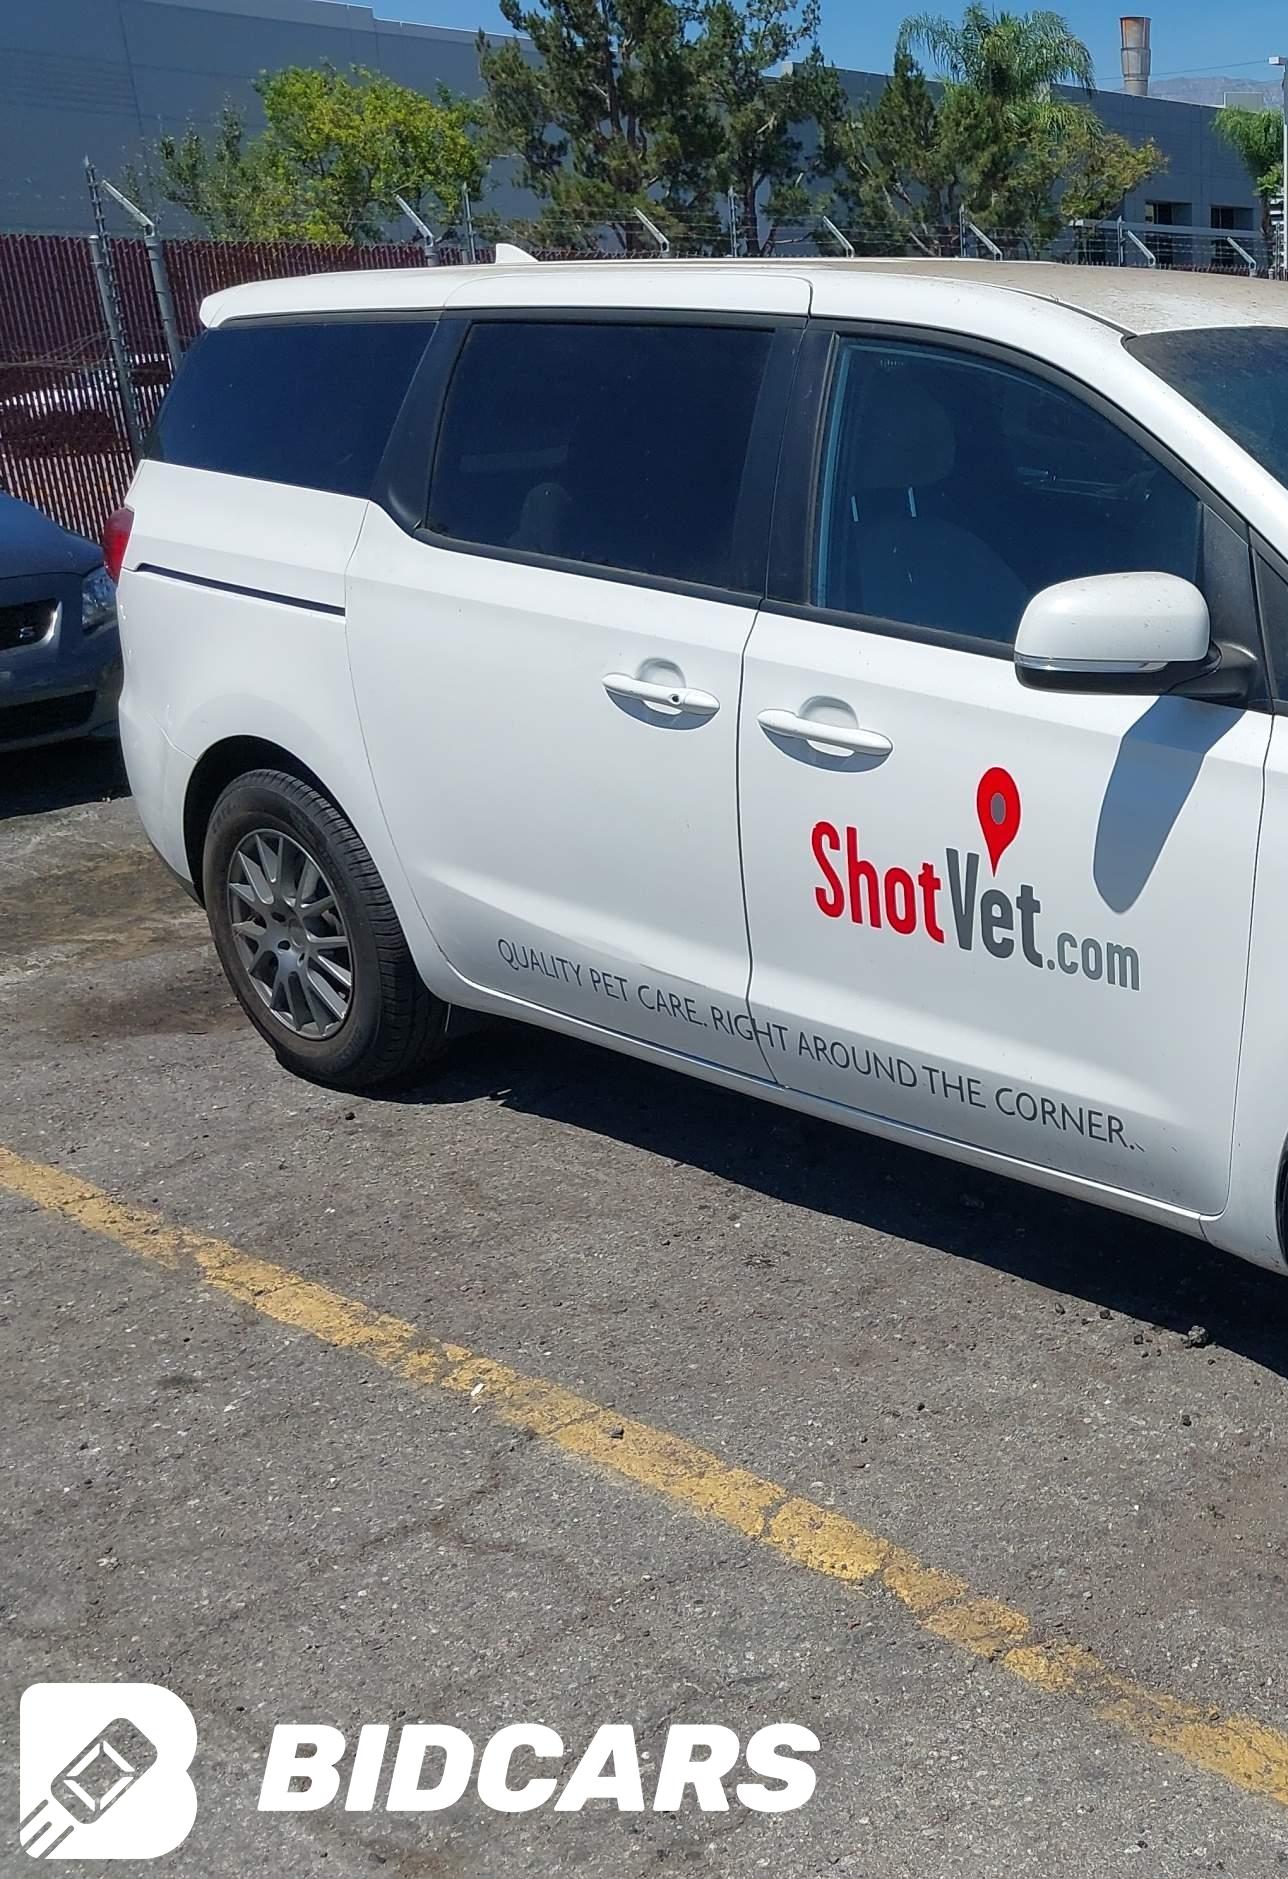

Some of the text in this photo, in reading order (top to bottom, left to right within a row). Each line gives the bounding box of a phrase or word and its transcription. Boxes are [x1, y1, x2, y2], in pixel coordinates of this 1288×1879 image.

[811, 820, 1141, 992] ShotVet.com
[497, 938, 583, 987] QUALITY
[589, 967, 628, 1002] PET
[637, 984, 708, 1028] CARE.
[709, 1005, 789, 1051] RIGHT
[798, 1031, 918, 1089] AROUND
[921, 1065, 987, 1109] THE
